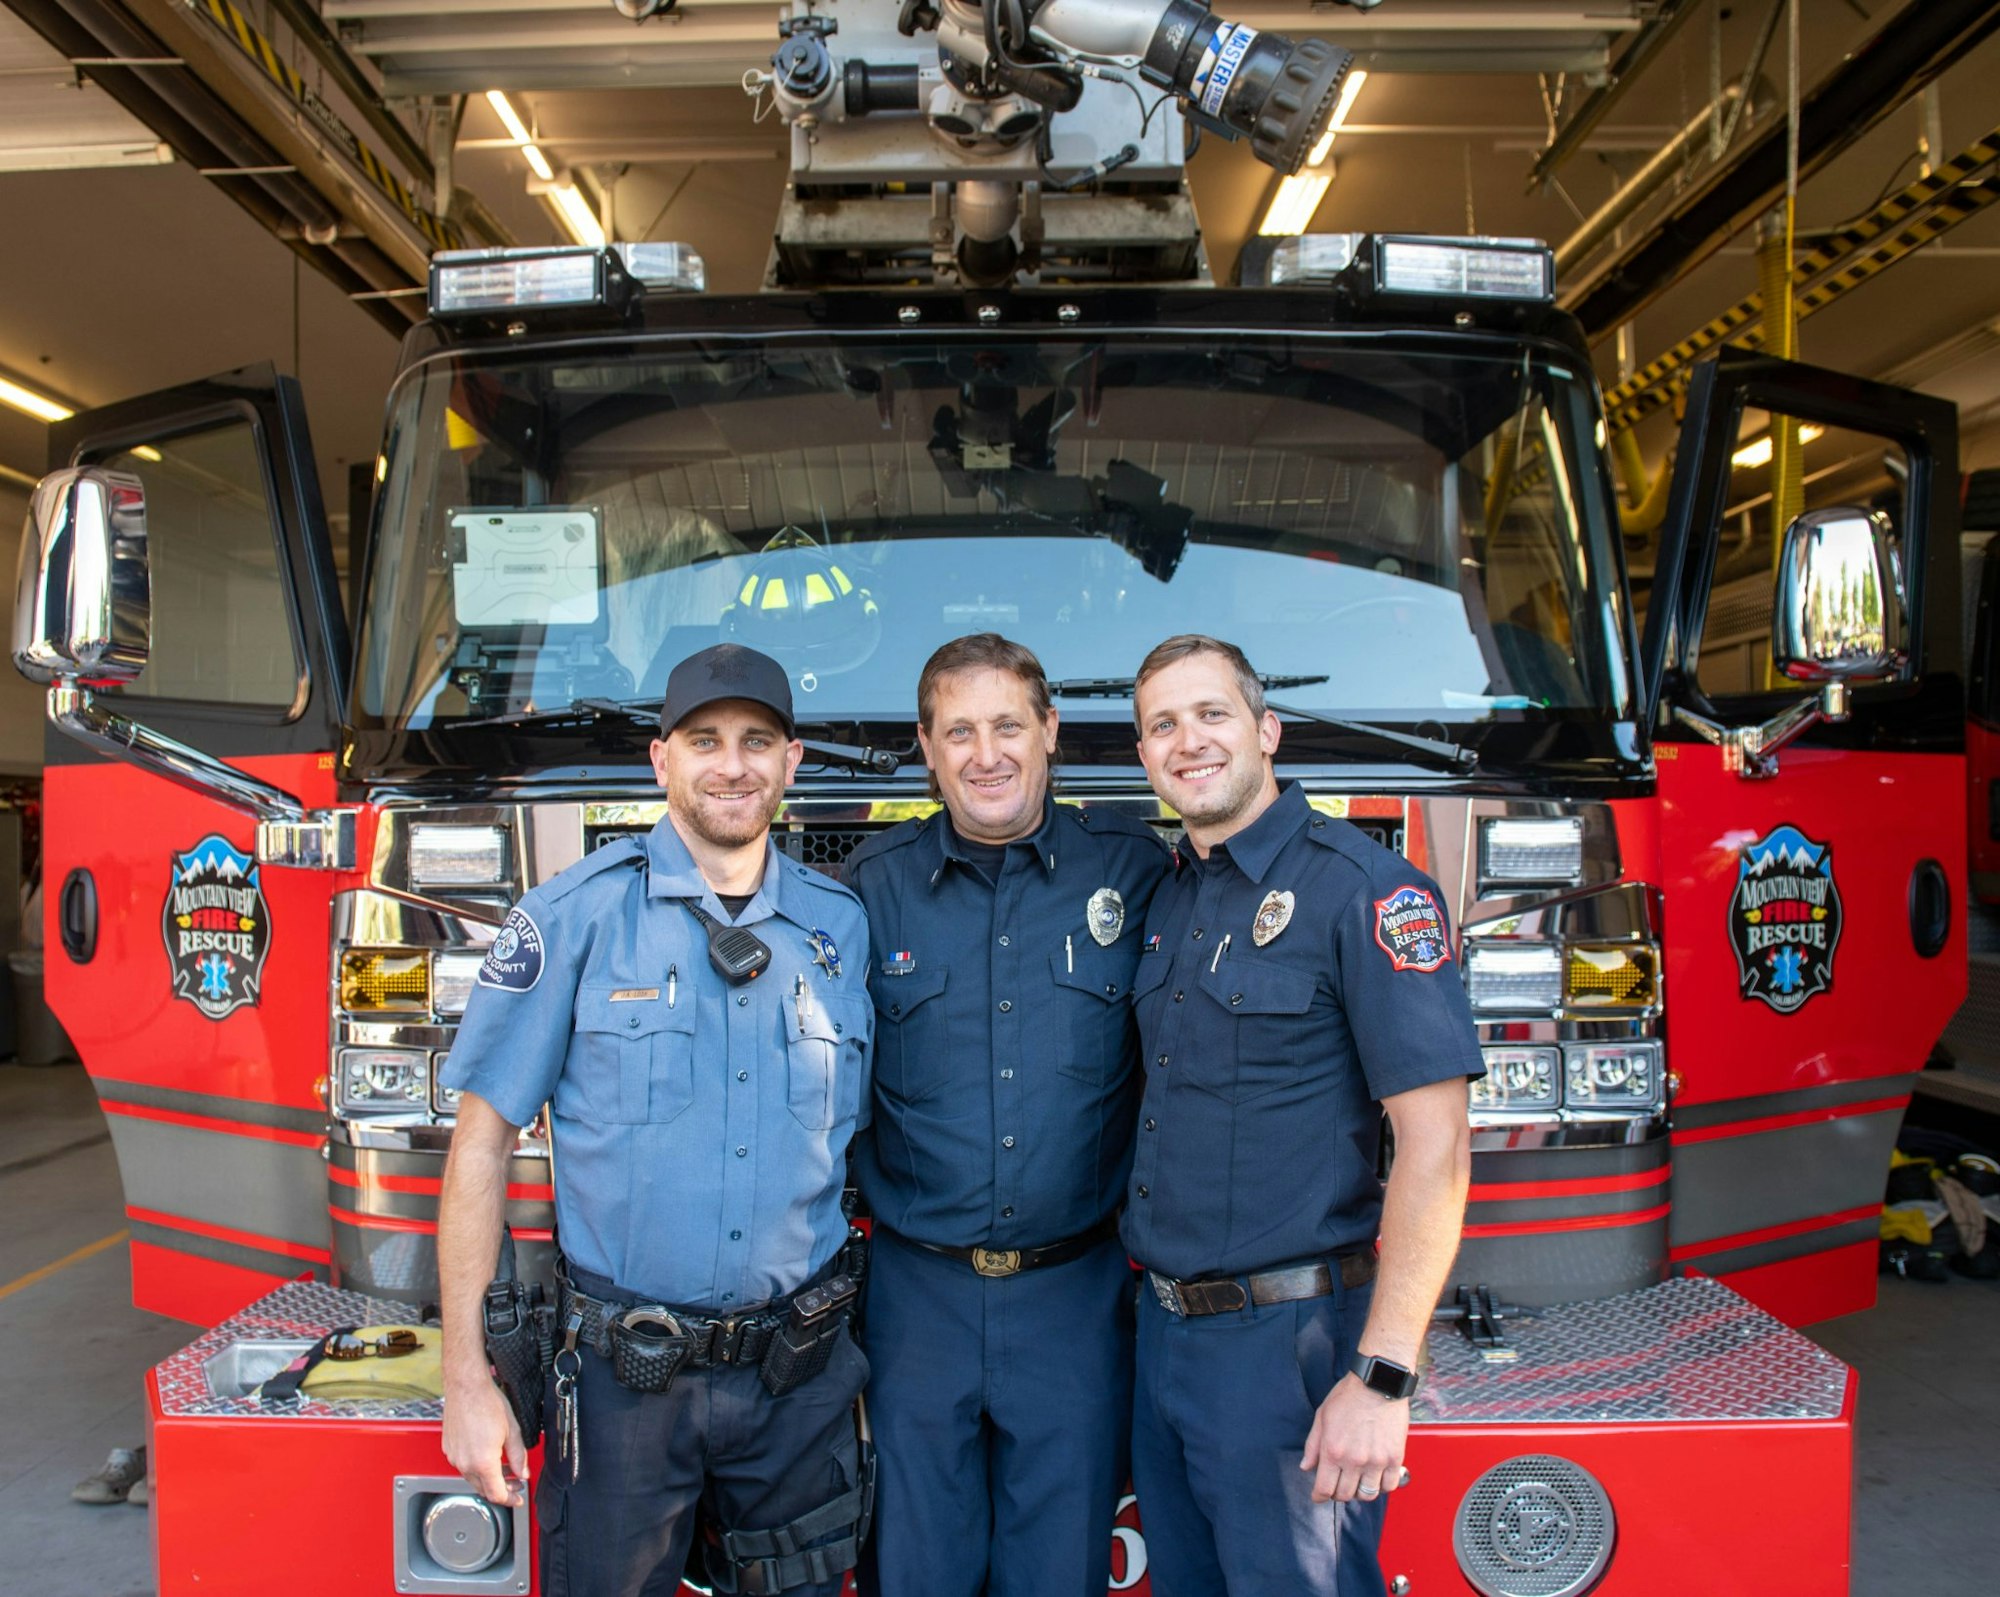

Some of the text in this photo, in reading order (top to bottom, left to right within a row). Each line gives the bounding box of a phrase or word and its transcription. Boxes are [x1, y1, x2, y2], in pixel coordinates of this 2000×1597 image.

[1211, 30, 1251, 87] MASTER
[174, 884, 258, 917] MOUNTAIN VIEW
[1741, 875, 1829, 910] MOUNTAIN VIEW
[192, 907, 239, 930] FIRE
[1382, 908, 1421, 931] MOUNTAIN
[1763, 900, 1811, 922] FIRE
[508, 911, 540, 953] ERIFF
[1393, 928, 1442, 950] RESCUE
[1402, 920, 1431, 934] FIRE
[1746, 922, 1827, 956] RESCUE
[178, 930, 255, 962] RESCUE
[490, 958, 527, 974] COUNTY
